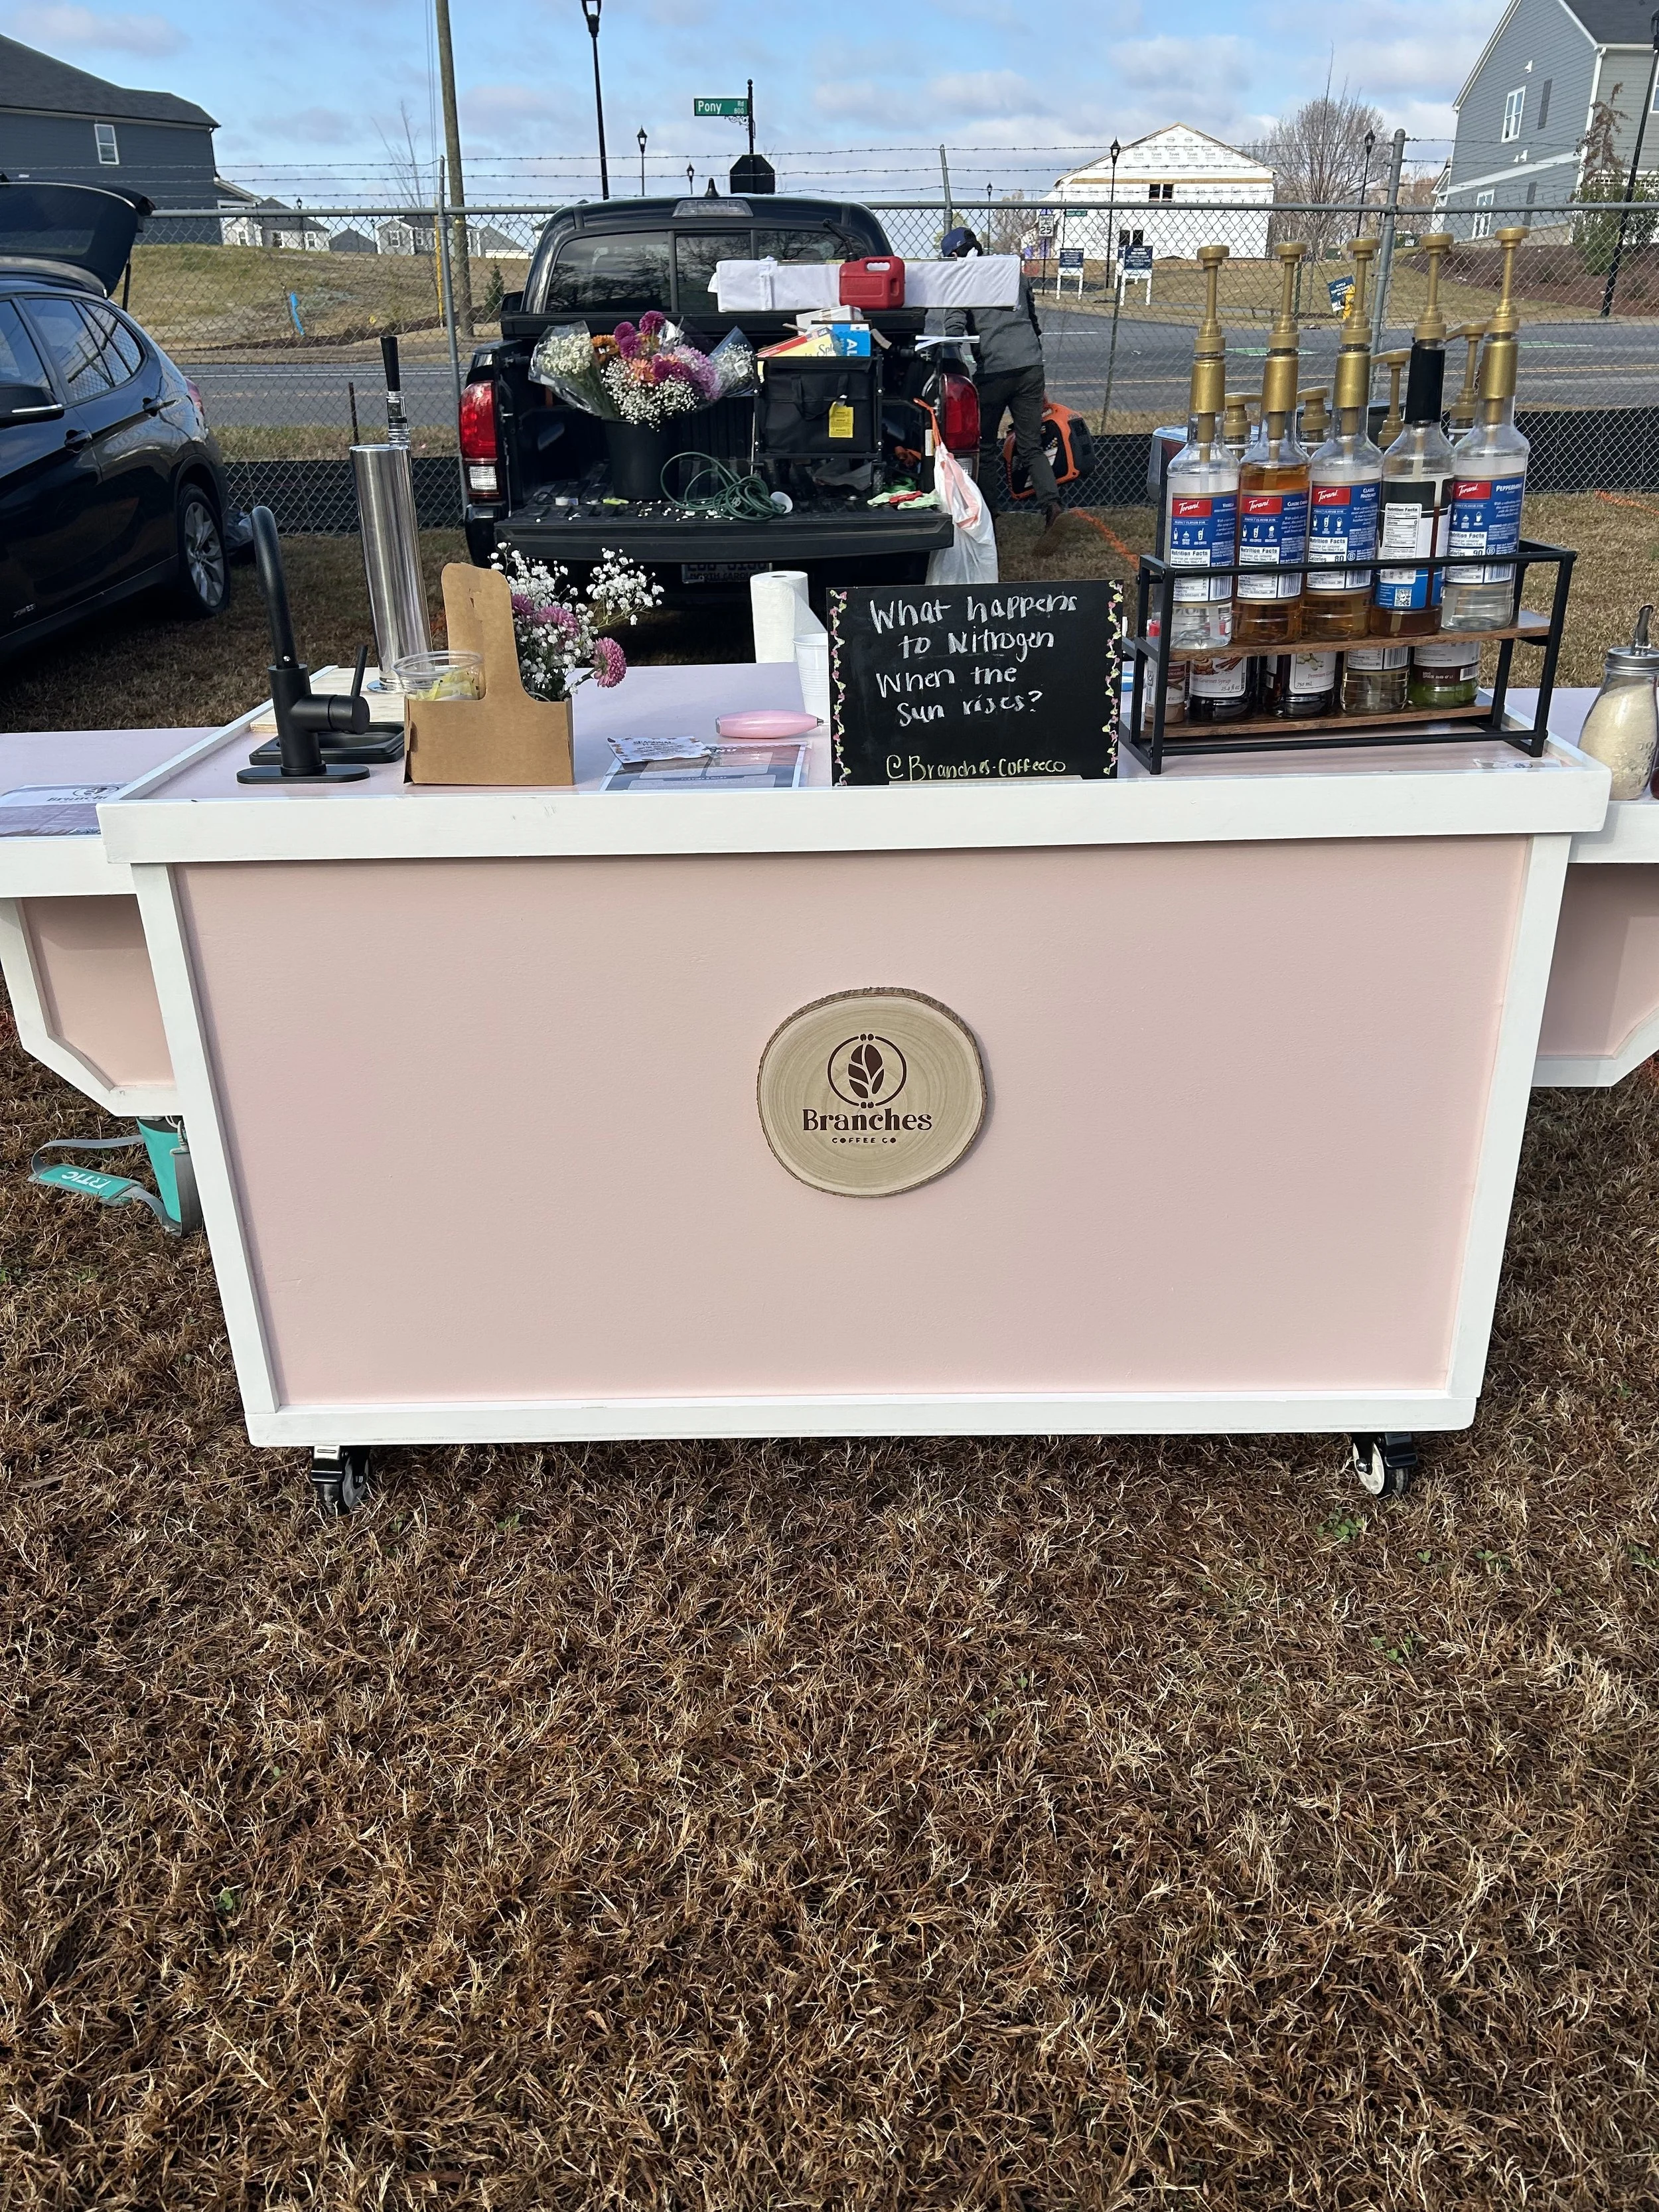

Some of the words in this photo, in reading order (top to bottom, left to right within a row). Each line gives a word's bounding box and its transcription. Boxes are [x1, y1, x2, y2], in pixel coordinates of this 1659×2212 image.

[698, 100, 722, 115] Pony
[1318, 490, 1338, 502] Torani
[1459, 484, 1479, 496] Torani
[1179, 501, 1200, 514] Torani
[1249, 499, 1270, 512] Torani
[870, 598, 951, 634] What
[967, 594, 1078, 624] happens
[899, 633, 932, 660] to
[948, 627, 1054, 662] Nitrogen
[876, 666, 956, 698] When
[970, 666, 1017, 685] the
[897, 702, 945, 727] Sun
[962, 691, 1043, 715] rises?
[802, 1107, 933, 1131] Branches
[61, 1171, 111, 1189] RTIC
